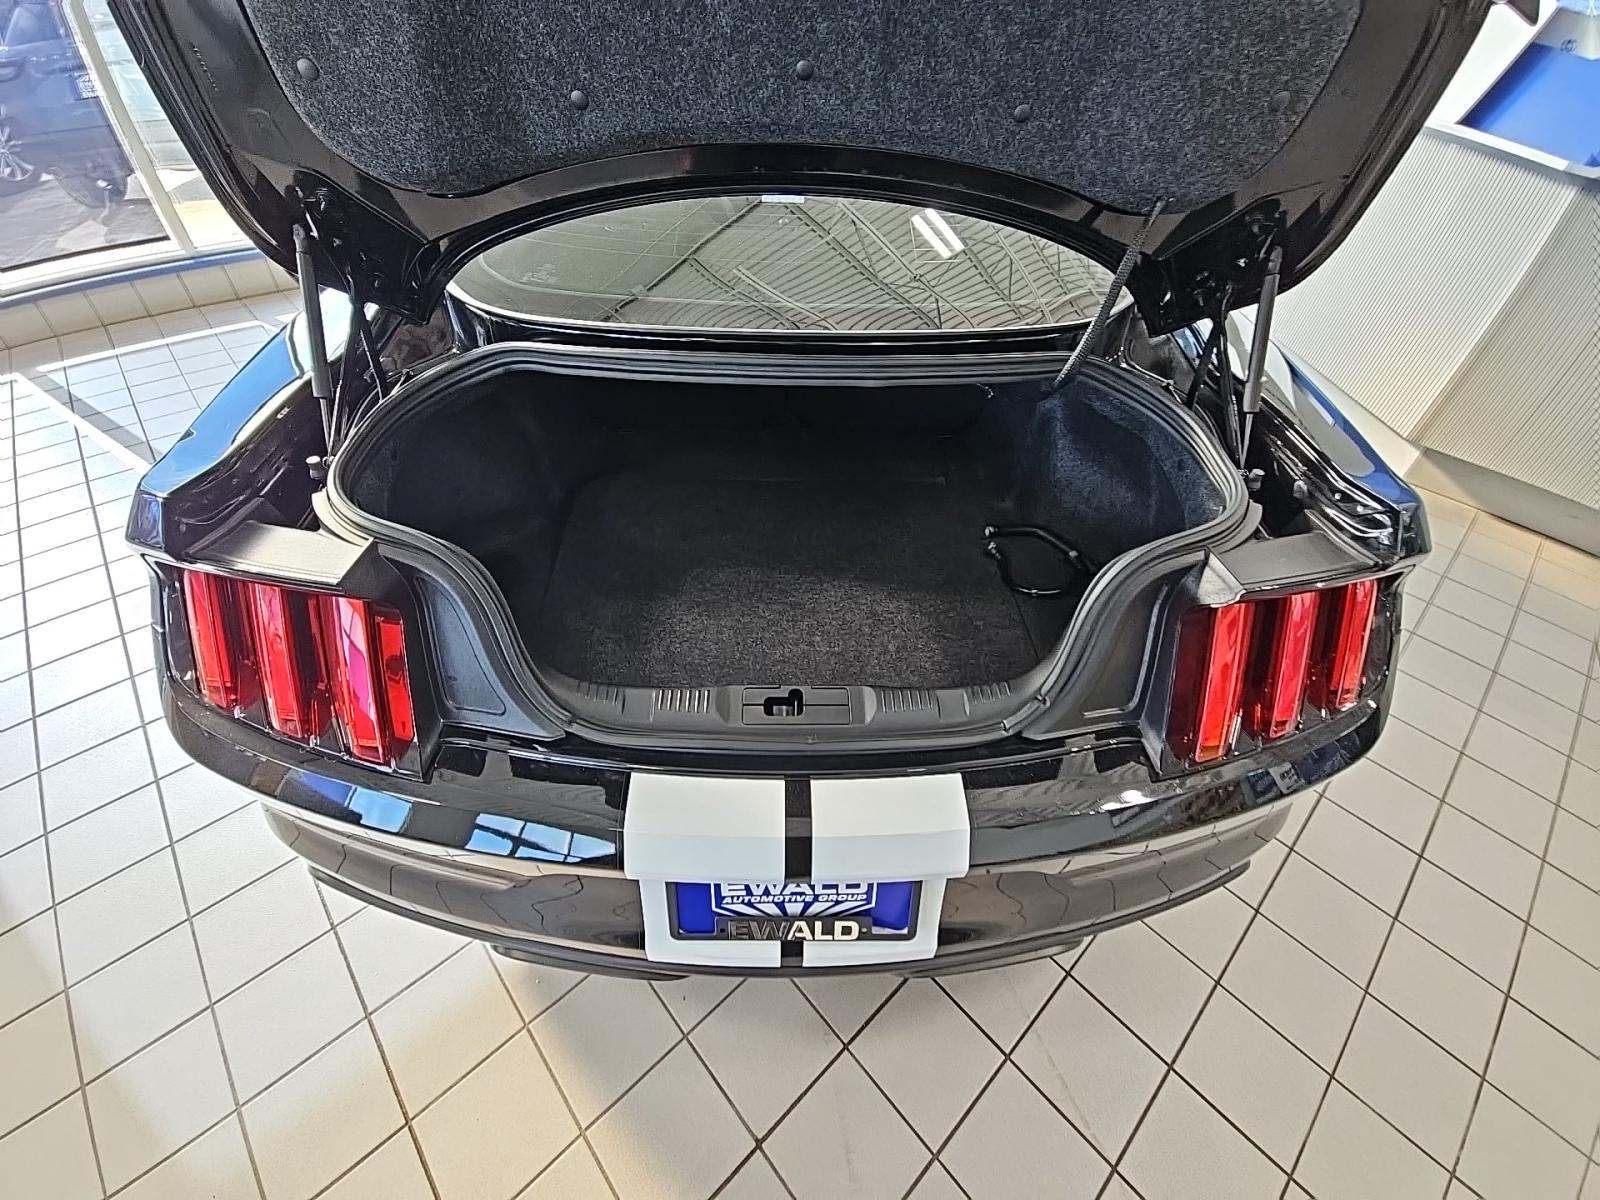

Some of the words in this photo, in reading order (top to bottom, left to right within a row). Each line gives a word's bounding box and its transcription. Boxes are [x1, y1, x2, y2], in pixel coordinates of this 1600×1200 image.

[721, 882, 868, 895] EWALD
[722, 895, 814, 904] AUTOMOTIVE
[818, 894, 867, 902] GROUP
[728, 920, 860, 940] EWALD
